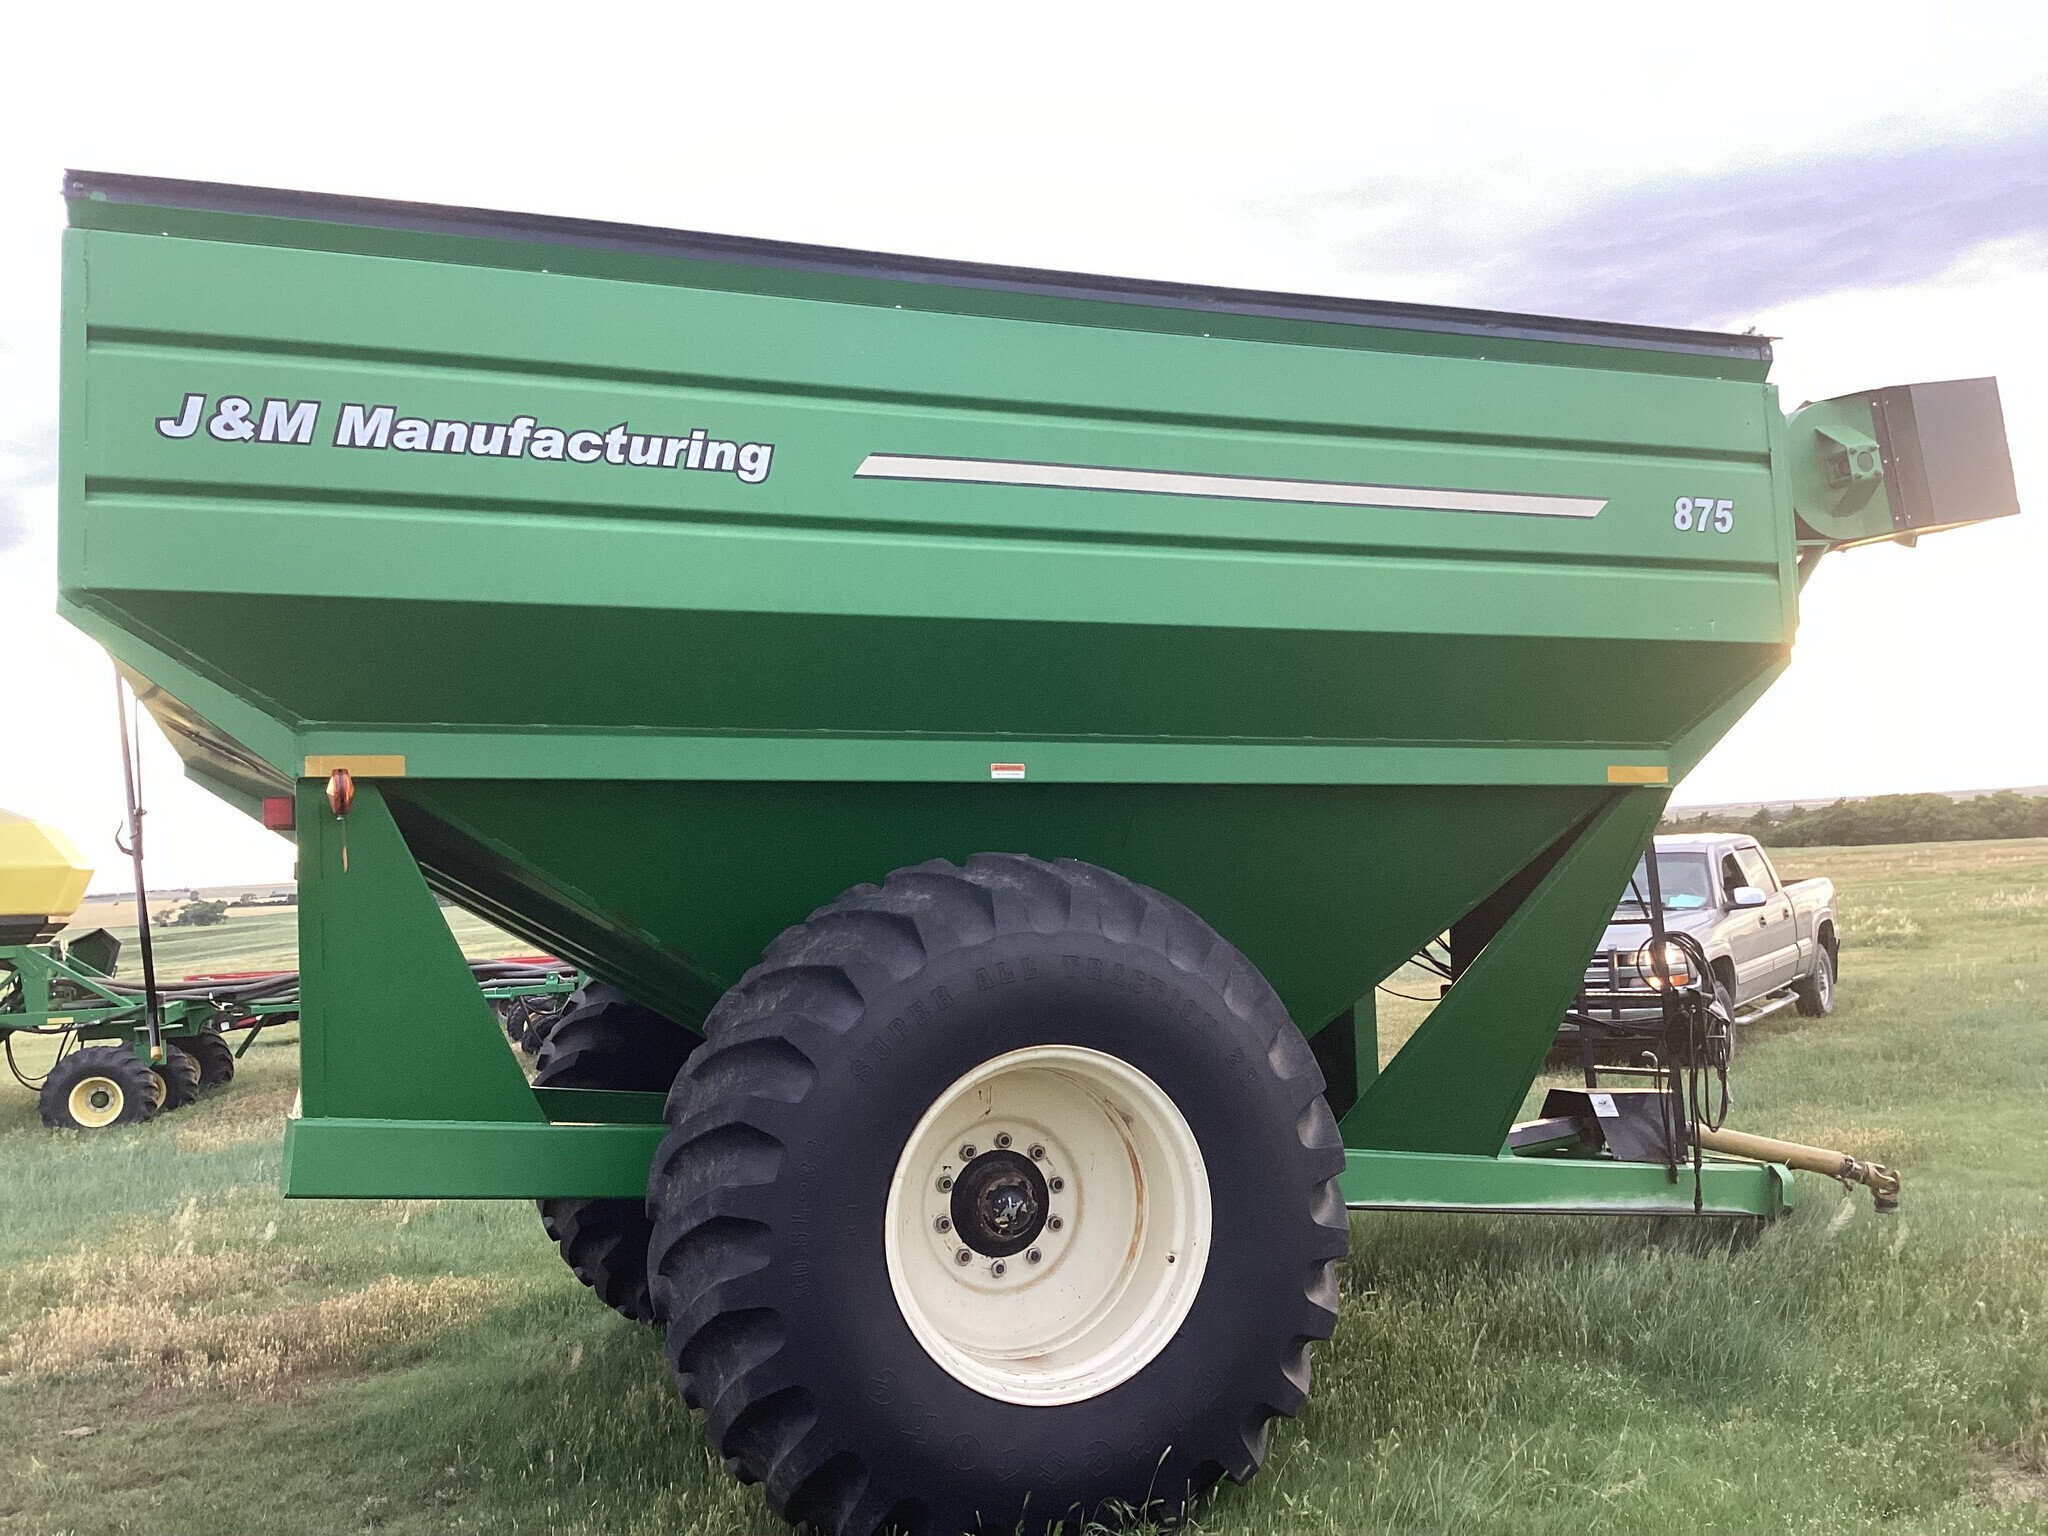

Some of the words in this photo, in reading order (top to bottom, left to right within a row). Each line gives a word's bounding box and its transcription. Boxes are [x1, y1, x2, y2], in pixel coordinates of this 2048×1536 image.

[156, 392, 322, 445] J&M
[333, 402, 775, 484] Manufacturing
[1674, 496, 1734, 534] 875
[851, 985, 956, 1083] SUPER
[974, 956, 1038, 992] ALL
